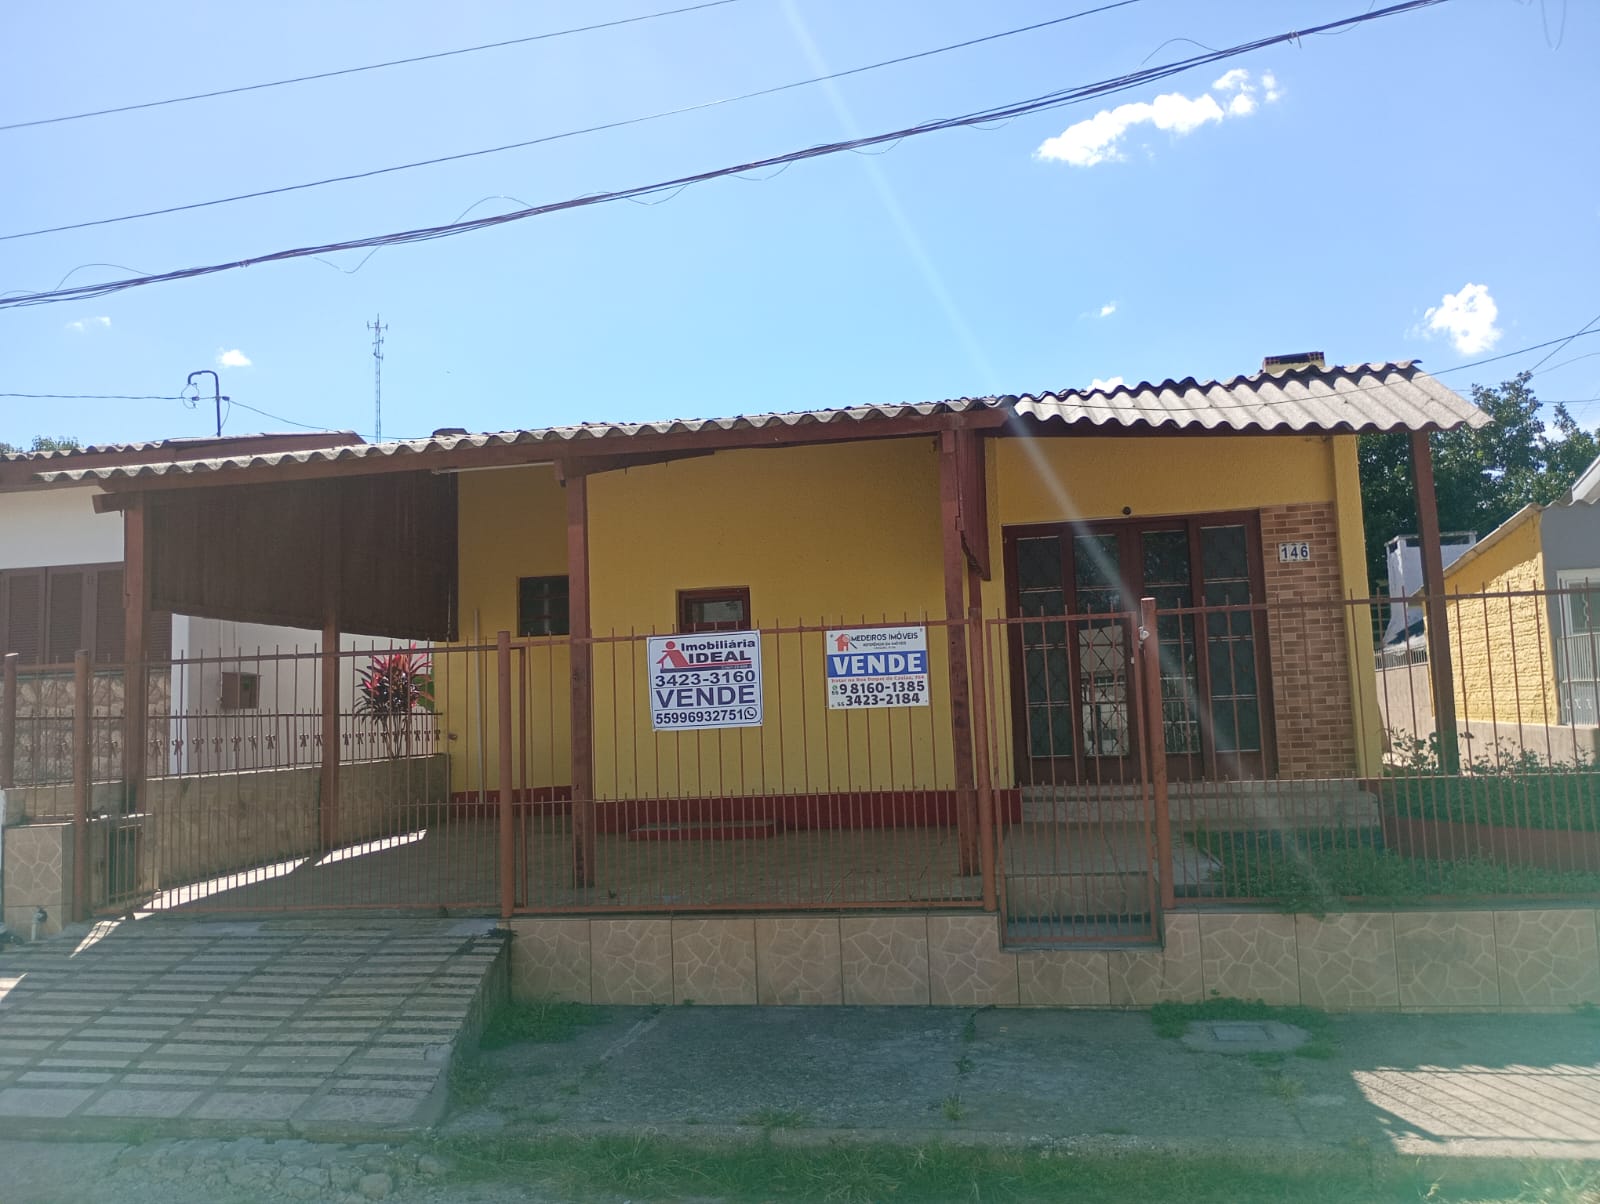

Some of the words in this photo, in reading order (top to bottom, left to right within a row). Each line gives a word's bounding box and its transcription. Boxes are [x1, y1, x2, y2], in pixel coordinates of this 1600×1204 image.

[1281, 545, 1308, 558] 146
[851, 633, 887, 642] MEDEIROS
[888, 632, 918, 641] IMÓVEIS
[681, 639, 755, 651] Imobiliária
[688, 650, 751, 664] IDEAL
[832, 653, 922, 675] VENDE
[655, 670, 755, 687] 3423-3160
[656, 685, 755, 708] VENDE
[846, 693, 920, 707] 3423-2184
[656, 709, 743, 724] 55996932751
